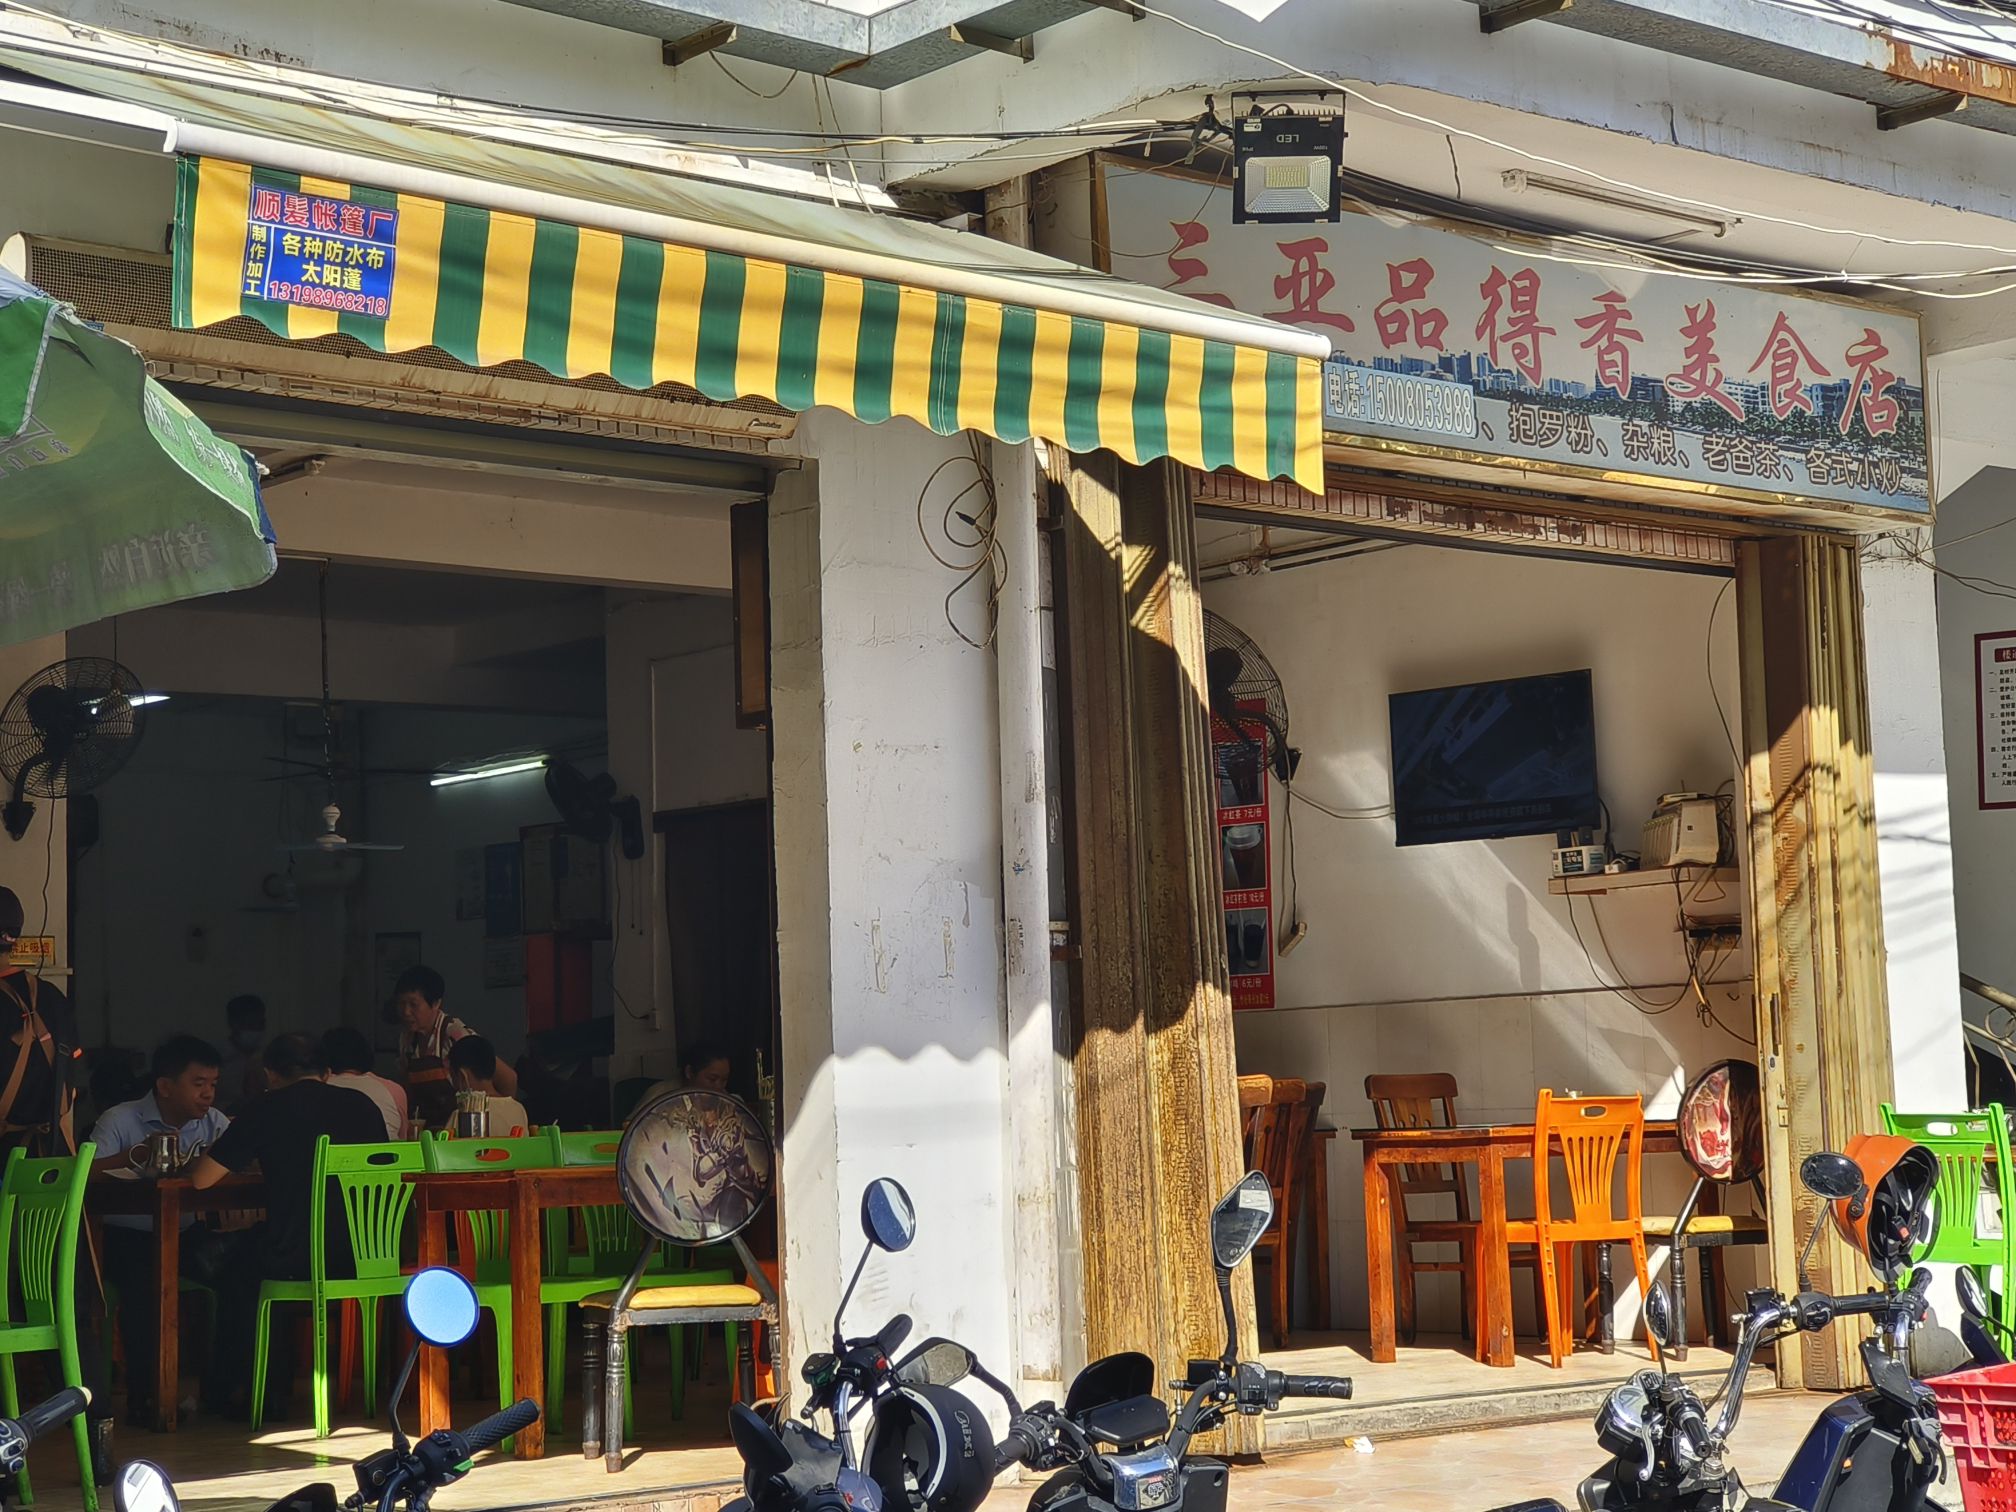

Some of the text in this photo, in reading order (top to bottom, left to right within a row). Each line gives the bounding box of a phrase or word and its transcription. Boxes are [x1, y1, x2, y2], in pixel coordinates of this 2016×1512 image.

[1276, 134, 1299, 143] LED
[244, 225, 267, 296] 制作加工
[282, 232, 386, 270] 各种防水布
[270, 281, 387, 316] 13198968218
[1163, 220, 1901, 438] 三亚品得香美食店
